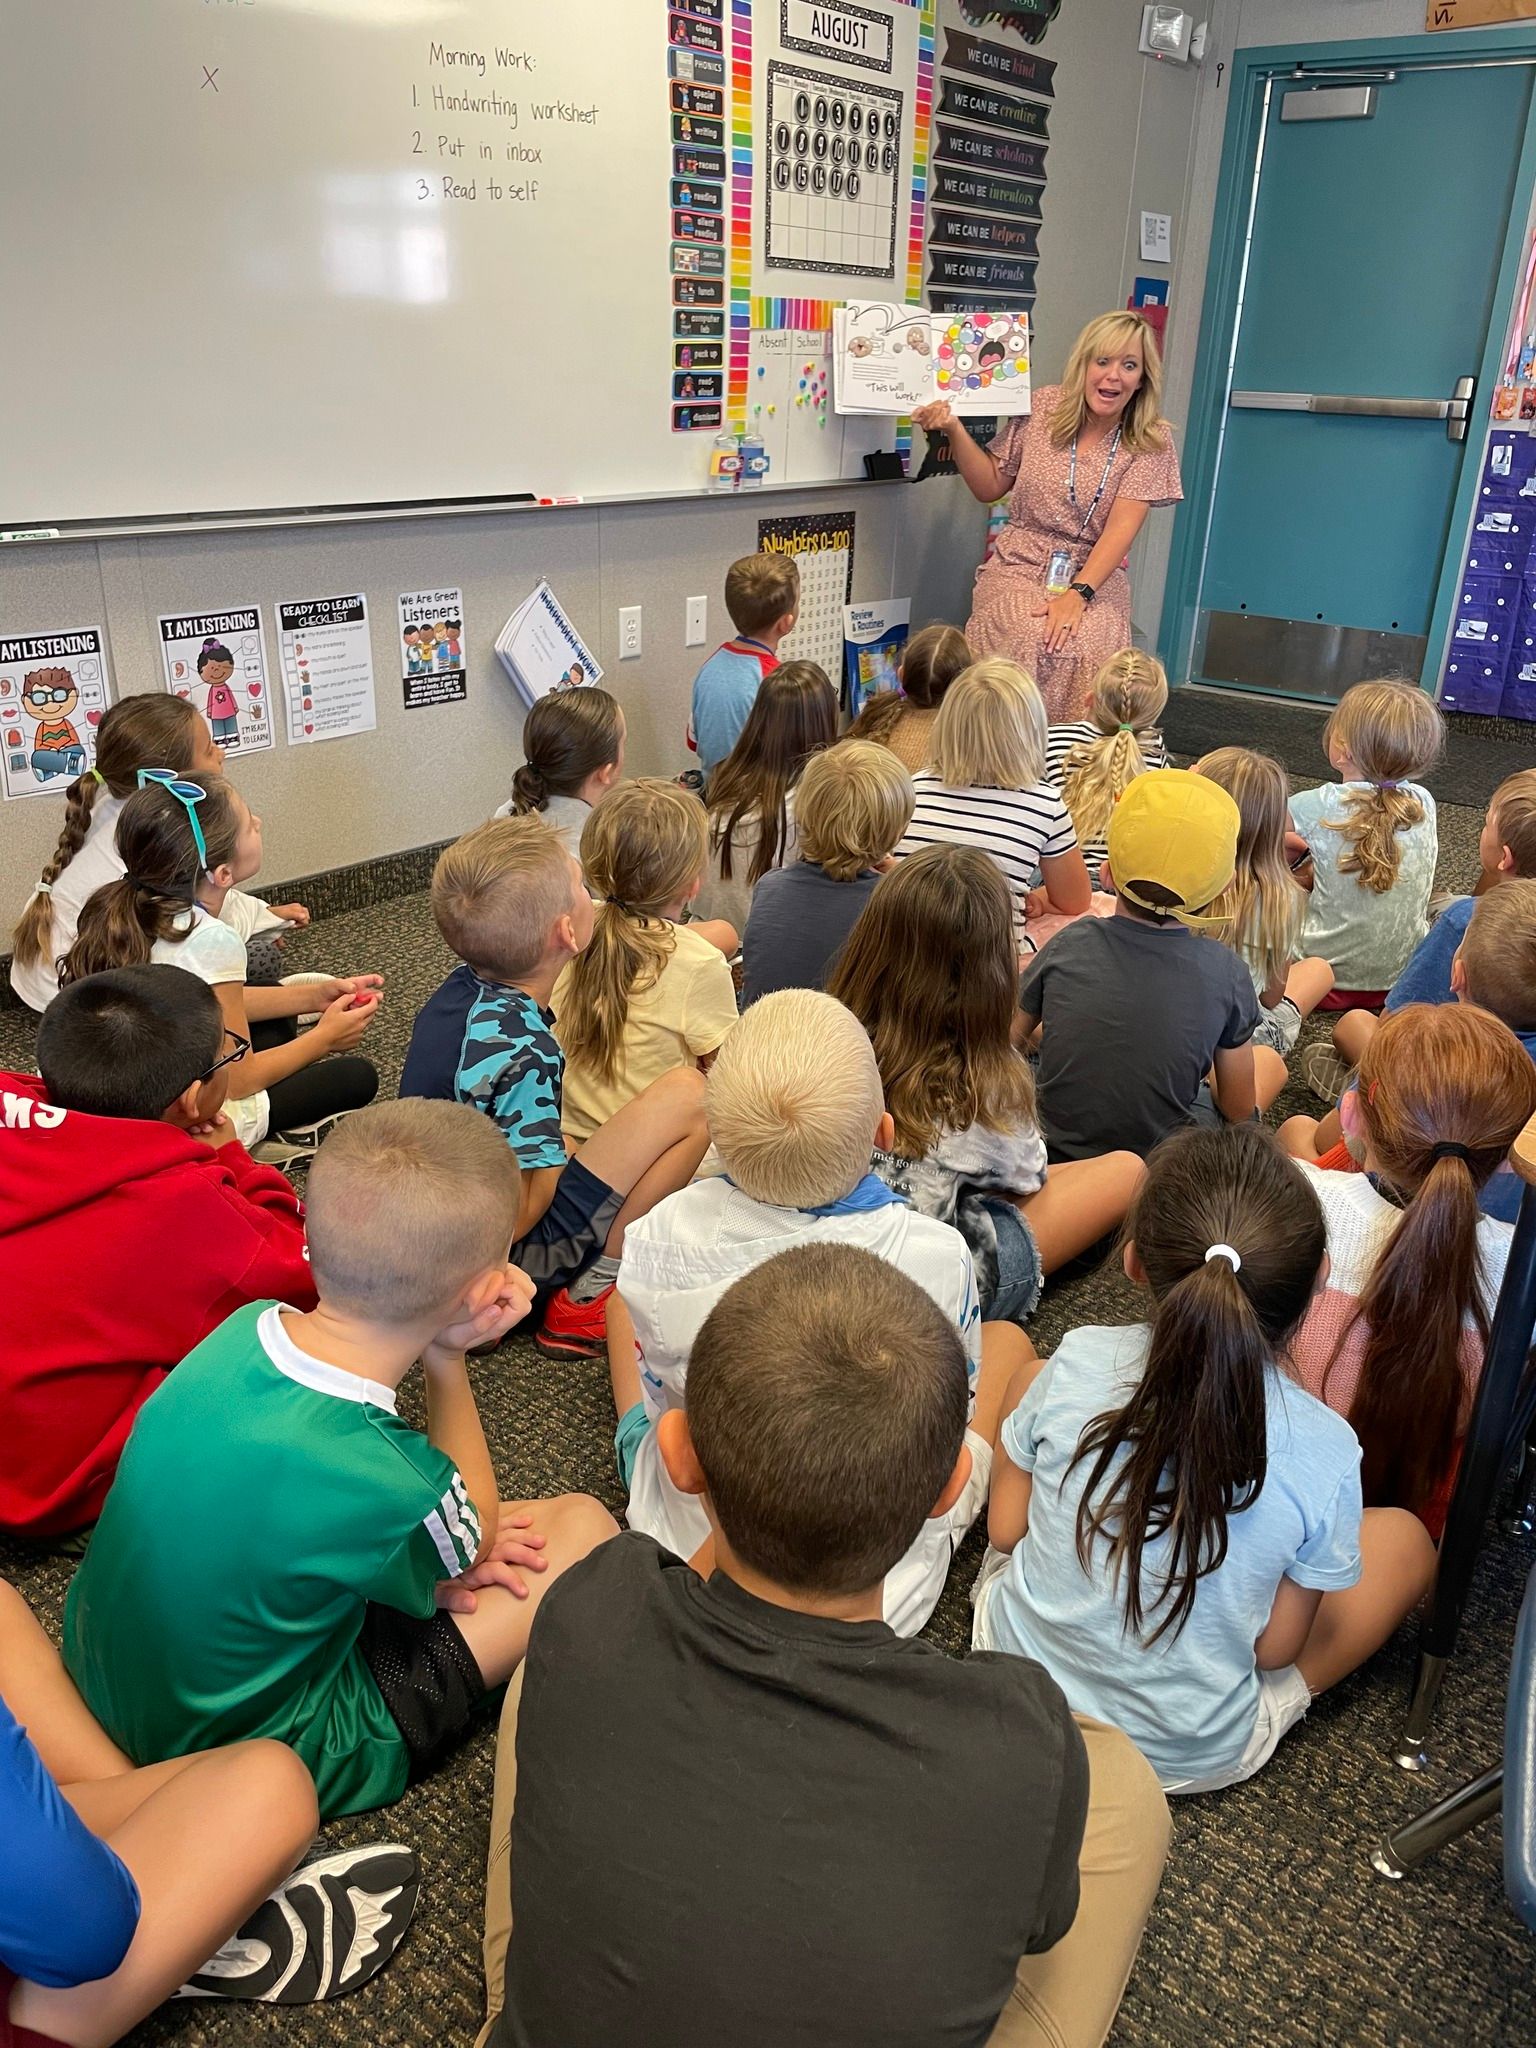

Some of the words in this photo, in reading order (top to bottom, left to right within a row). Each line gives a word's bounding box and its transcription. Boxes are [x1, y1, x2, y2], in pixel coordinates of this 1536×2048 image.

[811, 10, 868, 49] AUGUST
[429, 42, 486, 77] Morning
[495, 47, 537, 72] Work:
[694, 59, 722, 72] PHONICS
[967, 48, 982, 62] WE
[982, 53, 999, 70] CAN
[1000, 58, 1011, 72] BE
[1011, 58, 1035, 79] kind
[412, 84, 421, 107] 1.
[432, 84, 518, 129] Handwriting
[531, 100, 600, 125] worksheet
[954, 93, 969, 107] WE
[969, 97, 987, 112] CAN
[987, 101, 999, 115] BE
[999, 105, 1037, 125] creative
[695, 127, 717, 139] writing
[412, 130, 428, 153] 2.
[438, 135, 465, 157] Put
[479, 141, 493, 161] in
[506, 142, 543, 163] inbox
[949, 137, 964, 151] WE
[964, 141, 981, 155] CAN
[982, 145, 993, 157] BE
[994, 145, 1034, 166] scholars
[415, 178, 435, 200] 3.
[442, 176, 476, 200] Read
[486, 177, 503, 200] to
[509, 180, 539, 201] self
[943, 178, 958, 193] WE
[958, 182, 975, 196] CAN
[976, 185, 987, 197] BE
[988, 183, 1034, 206] inventors
[947, 222, 961, 236] WE
[962, 224, 978, 238] CAN
[979, 227, 990, 239] BE
[991, 225, 1026, 246] helpers
[944, 263, 958, 276] WE
[959, 265, 975, 277] CAN
[976, 266, 987, 278] BE
[987, 263, 1025, 282] friends
[759, 331, 788, 348] Absent
[797, 332, 822, 348] School
[762, 530, 818, 558] Numbers
[820, 530, 850, 552] 0-100
[282, 604, 314, 617] READY
[315, 602, 330, 612] TO
[331, 598, 361, 611] LEARN
[400, 596, 413, 606] We
[416, 594, 432, 604] Are
[434, 590, 458, 602] Great
[165, 622, 174, 639] I
[175, 620, 195, 638] AM
[194, 613, 256, 635] LISTENING
[298, 611, 349, 627] CHECKLIST
[403, 605, 460, 623] Listeners
[1, 642, 20, 662] AM
[22, 634, 95, 657] LISTENING
